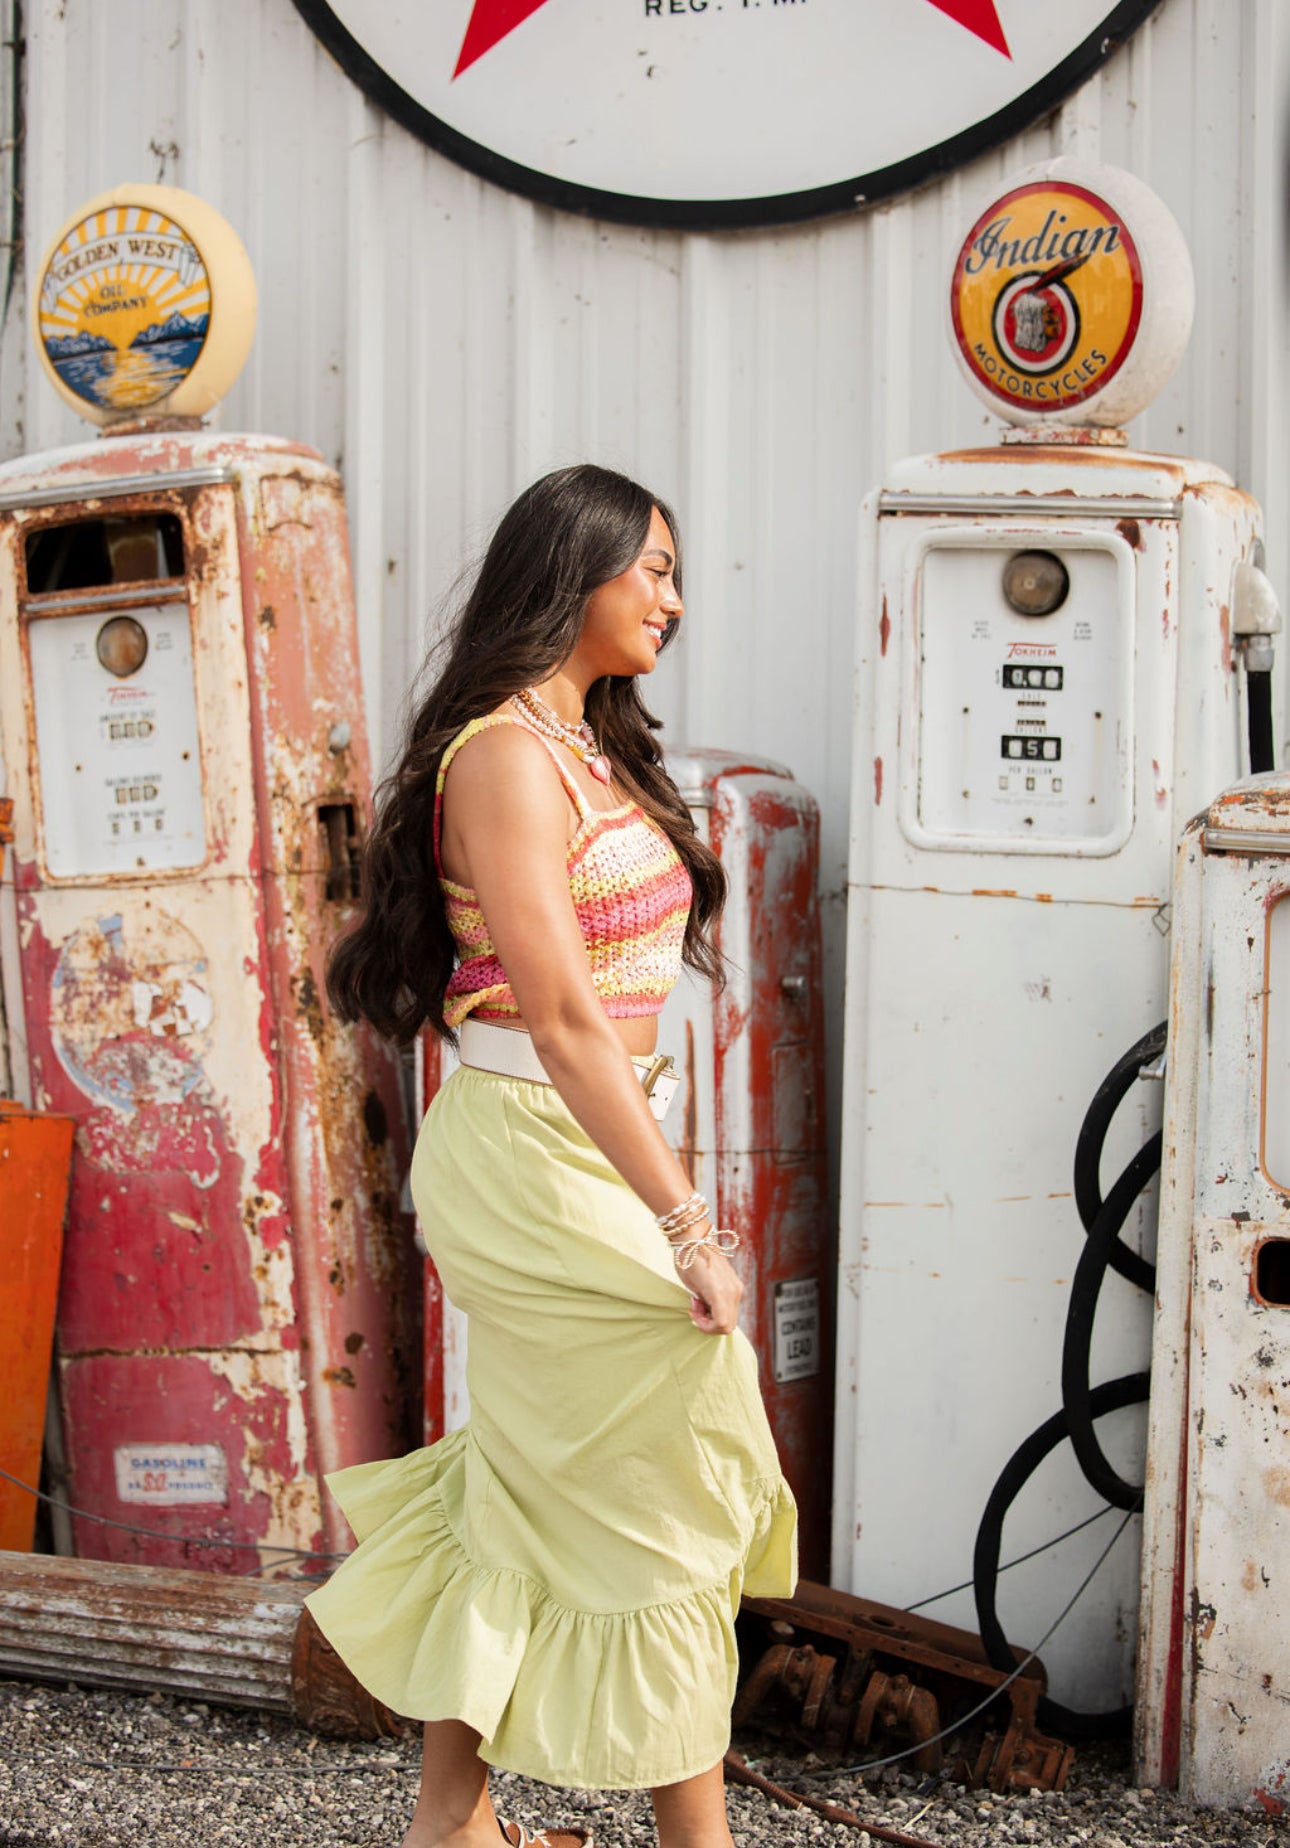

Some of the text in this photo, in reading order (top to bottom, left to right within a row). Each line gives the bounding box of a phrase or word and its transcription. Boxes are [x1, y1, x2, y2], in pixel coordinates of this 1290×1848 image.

[645, 0, 722, 16] REG.
[965, 209, 1121, 275] Indian
[57, 239, 179, 281] GOLDEN WEST
[100, 283, 125, 299] OIL
[84, 296, 147, 317] COMPANY
[973, 342, 1107, 399] MOTORCYCLES
[131, 1458, 206, 1469] GASOLINE
